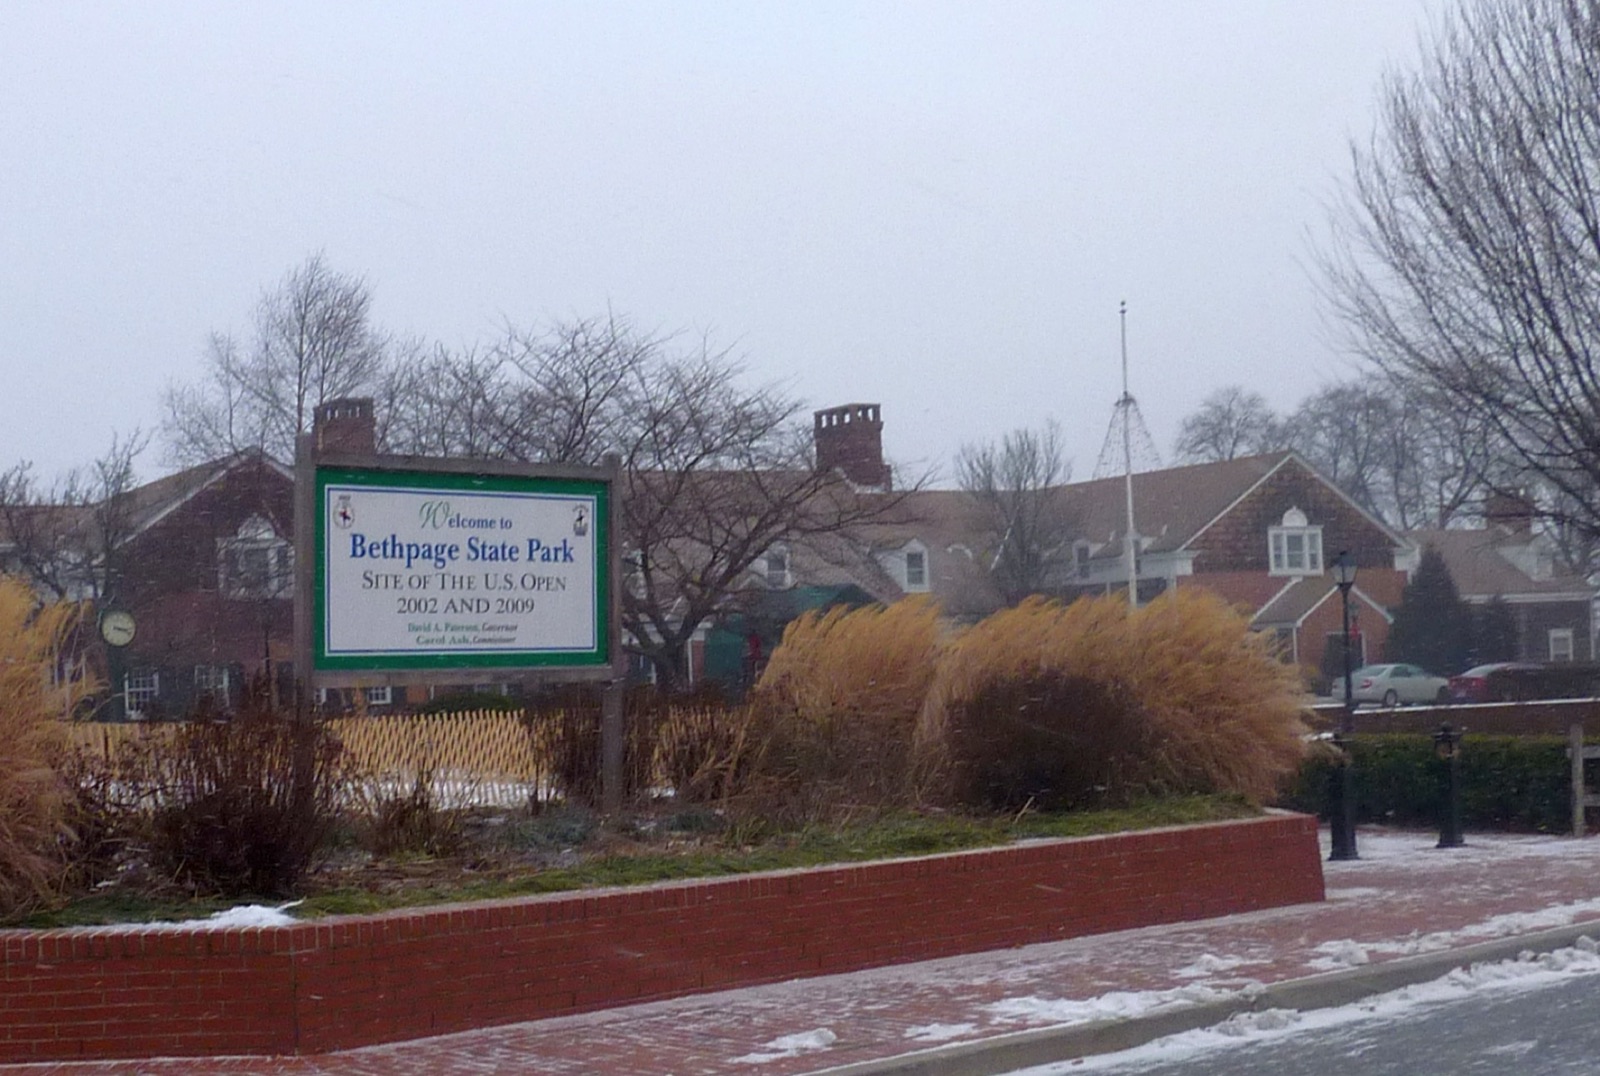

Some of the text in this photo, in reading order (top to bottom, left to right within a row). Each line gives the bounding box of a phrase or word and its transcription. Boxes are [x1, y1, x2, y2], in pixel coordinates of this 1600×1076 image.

[420, 500, 512, 530] Welcome to
[350, 533, 575, 569] Bethpage State Park
[362, 571, 567, 592] SITE OF THE U.S. OPEN
[397, 598, 535, 614] 2002 AND 2009
[416, 635, 445, 645] Carol
